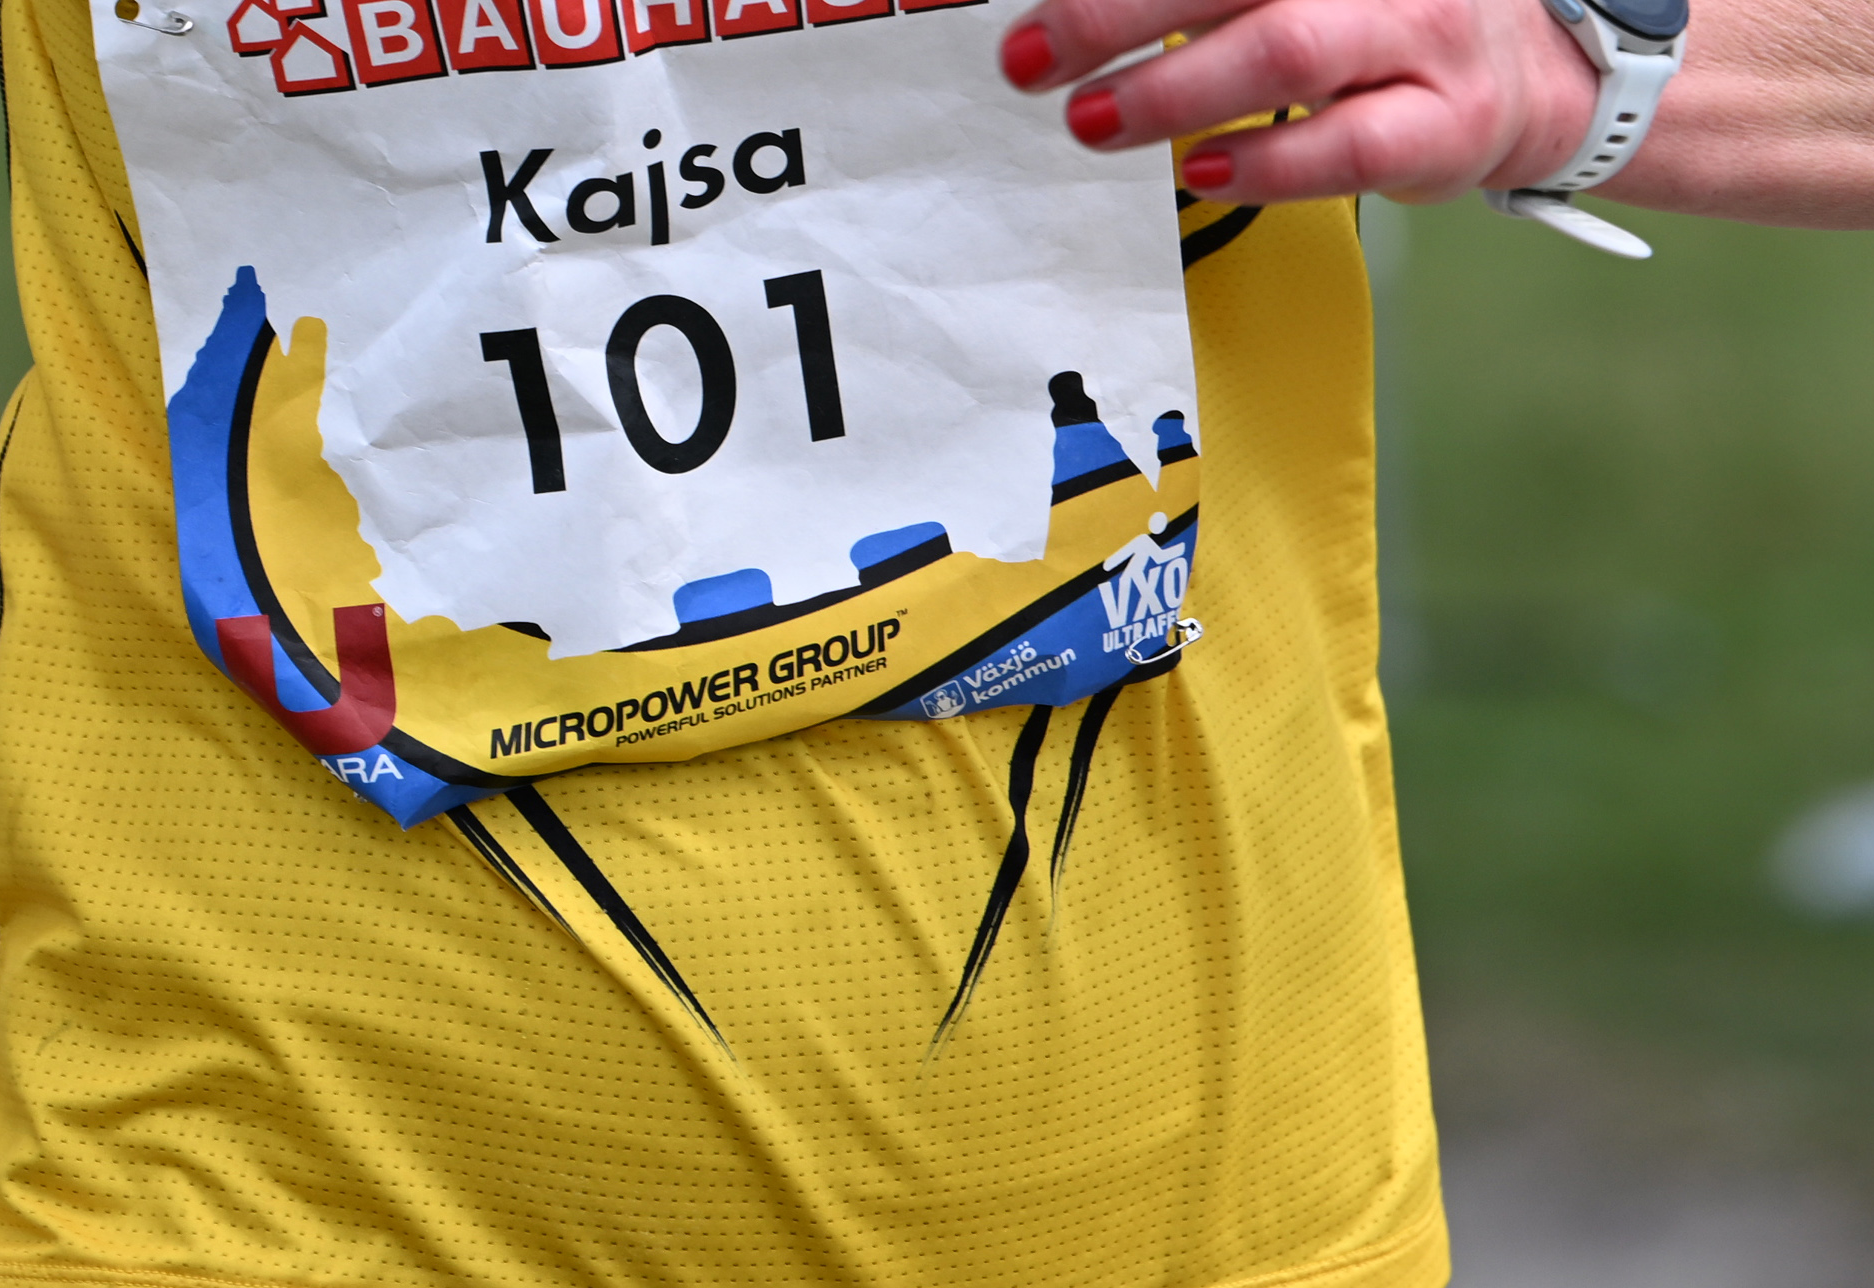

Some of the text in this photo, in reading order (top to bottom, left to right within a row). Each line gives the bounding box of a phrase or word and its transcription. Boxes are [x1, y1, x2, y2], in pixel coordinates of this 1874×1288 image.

[479, 127, 807, 247] Kajsa
[478, 268, 846, 495] 101
[1098, 557, 1189, 630] VXO
[489, 617, 901, 760] MICROPOWER GROUP
[615, 656, 888, 748] POWERFUL SOLUTIONS PARTNER
[963, 640, 1038, 690] Växjö
[970, 647, 1077, 704] kommun
